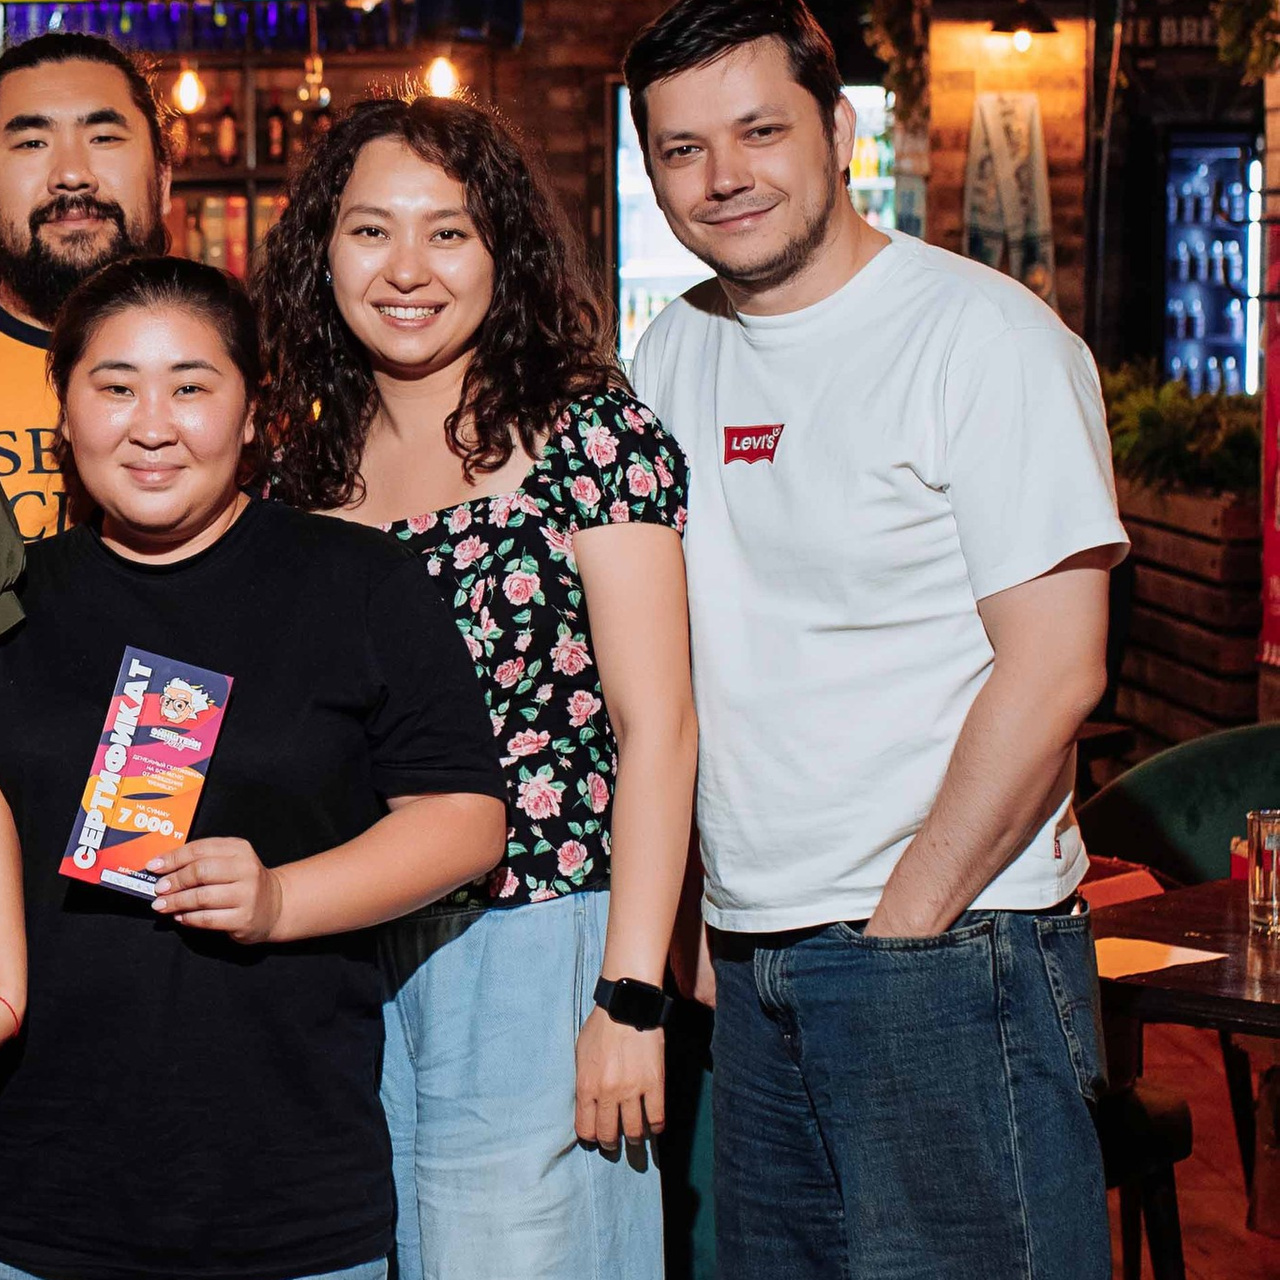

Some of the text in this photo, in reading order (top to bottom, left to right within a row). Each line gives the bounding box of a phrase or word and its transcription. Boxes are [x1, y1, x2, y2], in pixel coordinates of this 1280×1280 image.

[73, 658, 153, 870] СЕРТИФИКАТ
[118, 808, 133, 823] 7
[134, 812, 174, 836] 000
[146, 807, 171, 818] СУММУ
